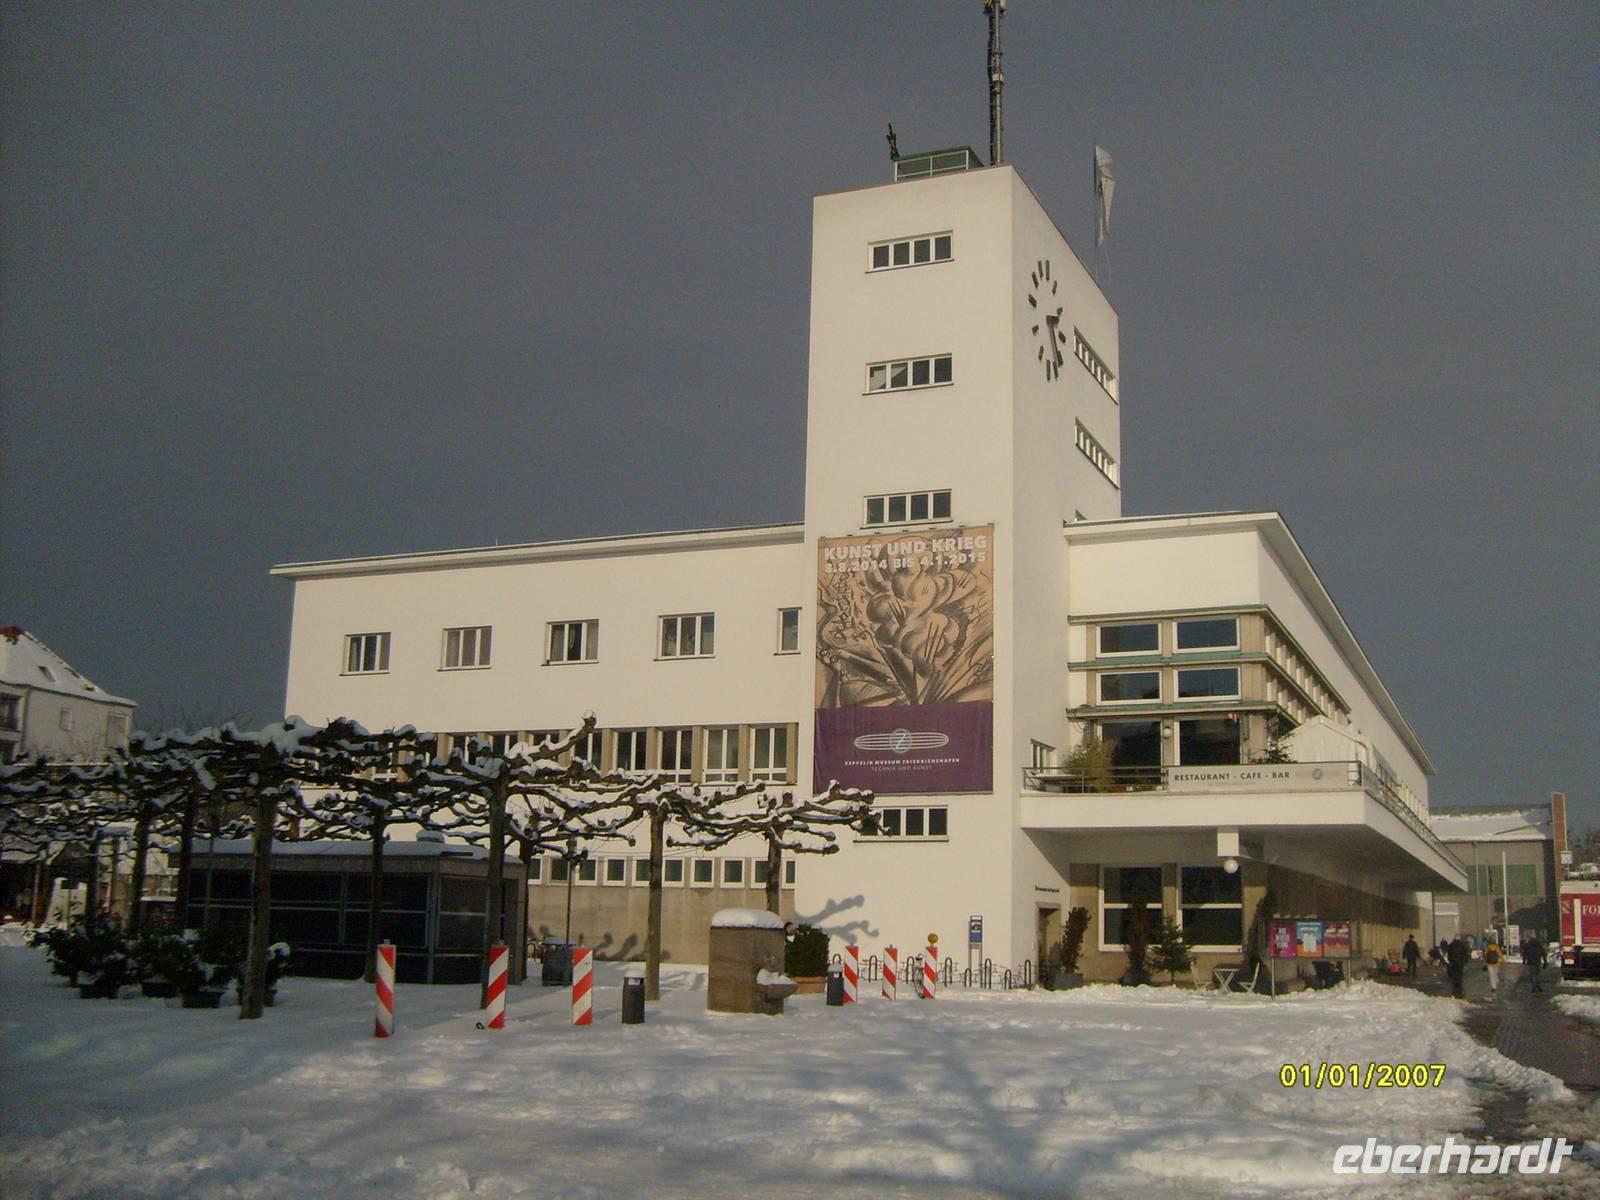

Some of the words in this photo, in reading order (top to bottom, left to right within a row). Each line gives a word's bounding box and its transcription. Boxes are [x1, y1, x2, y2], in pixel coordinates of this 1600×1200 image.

[824, 544, 882, 560] KUNST
[887, 541, 926, 555] UND
[931, 536, 987, 552] KRIEG
[824, 559, 888, 574] 8.8.2014
[893, 558, 914, 569] BIS
[920, 552, 986, 566] 4.1.2015
[1174, 773, 1230, 781] RESTAURANT
[1272, 771, 1290, 779] BAR
